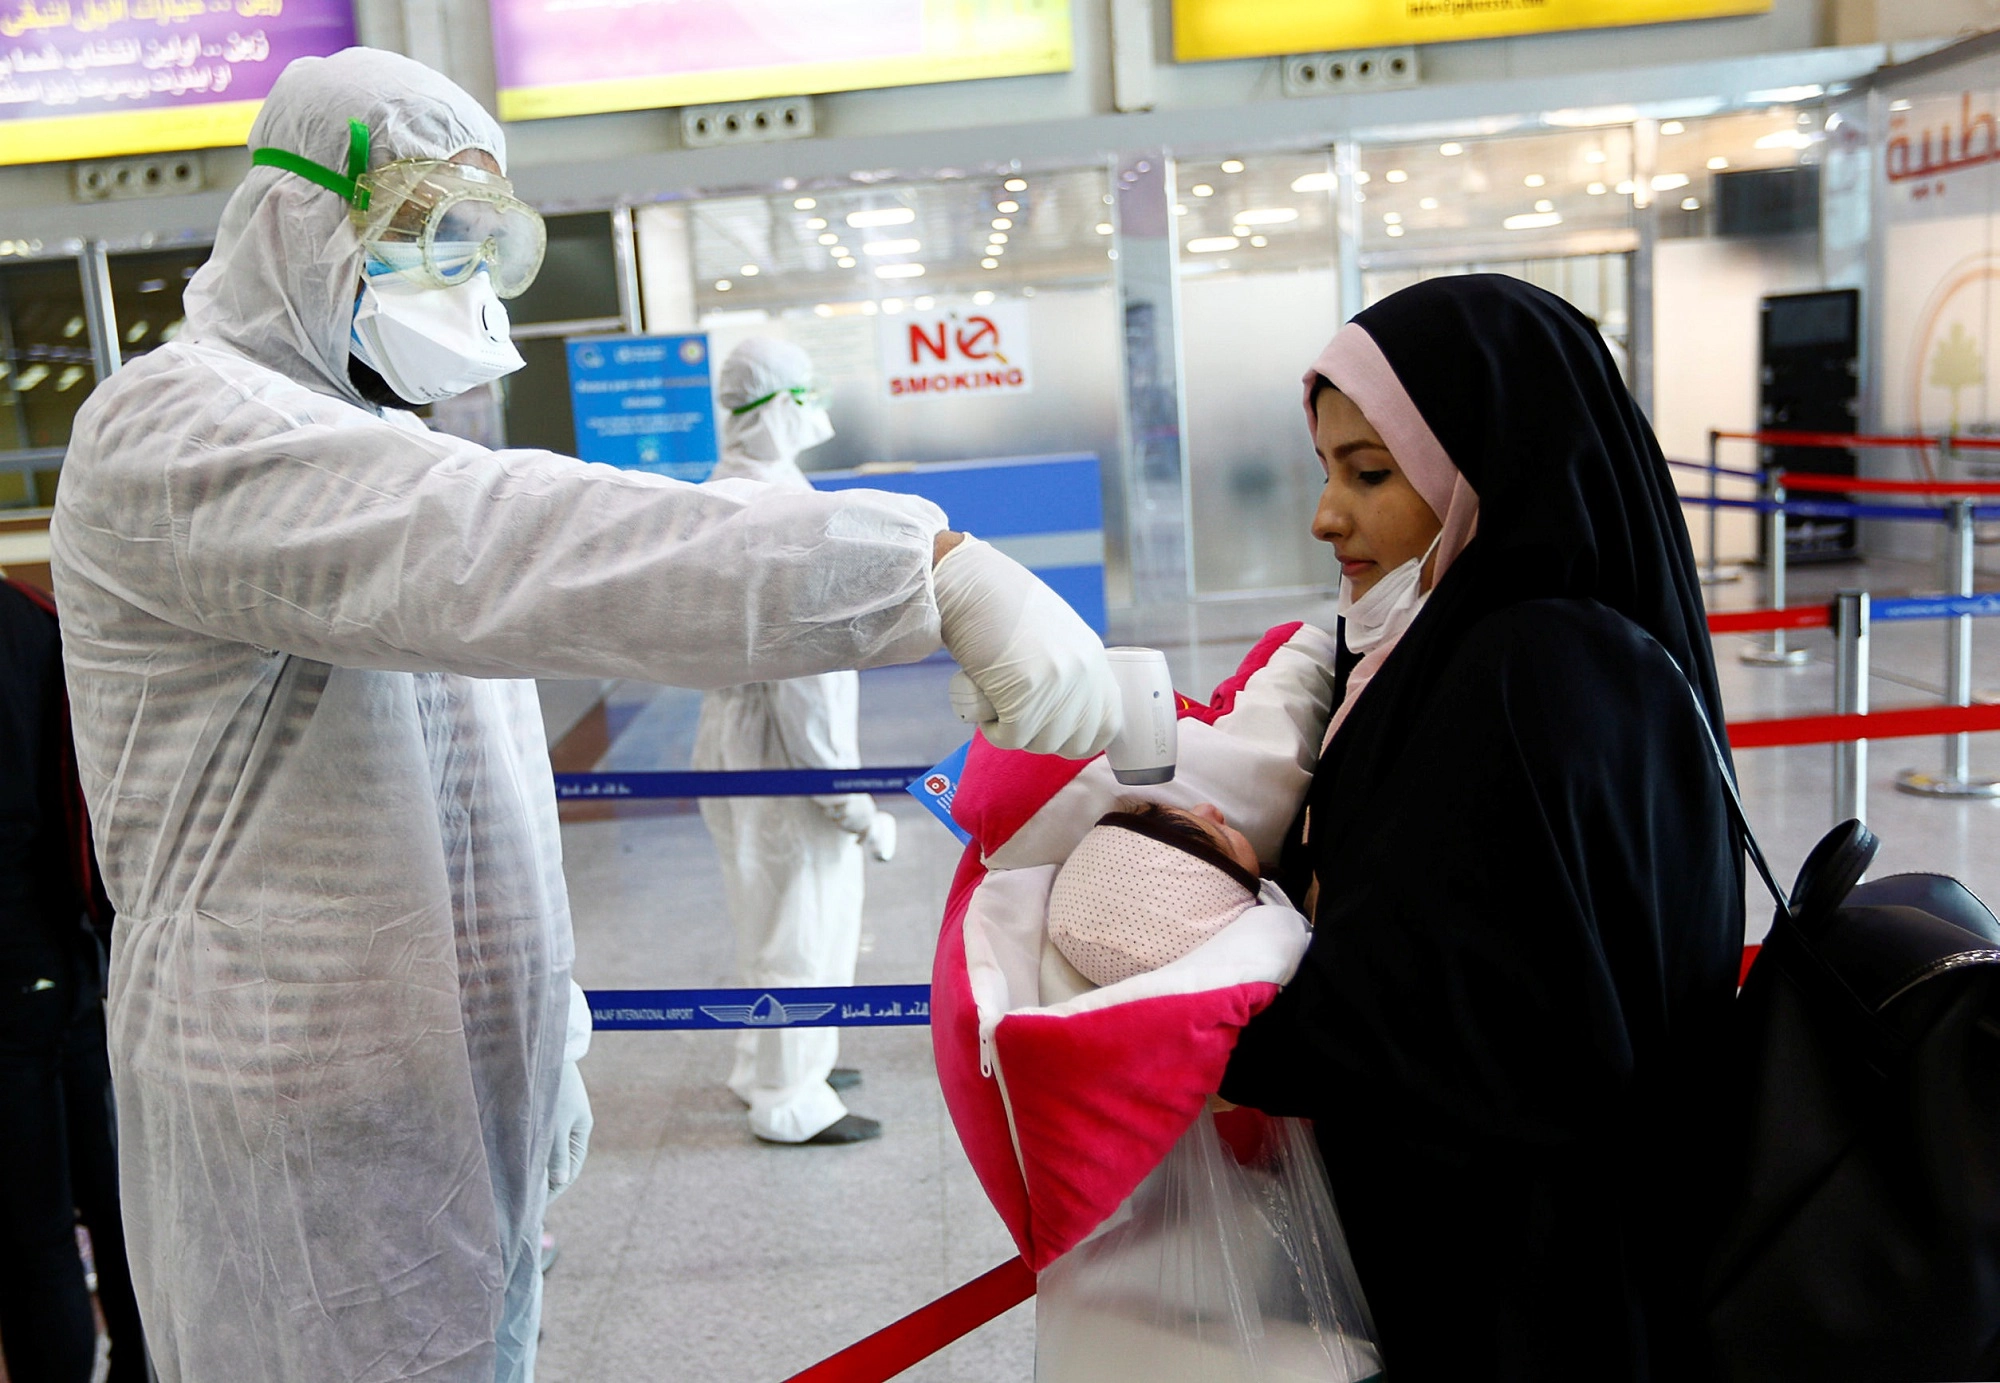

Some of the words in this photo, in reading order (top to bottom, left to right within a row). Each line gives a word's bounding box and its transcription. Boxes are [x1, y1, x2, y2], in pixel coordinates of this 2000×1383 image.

[890, 368, 1024, 396] SMOKING
[615, 1008, 666, 1021] INTERNATIONAL
[665, 1008, 694, 1020] AIRPORT
